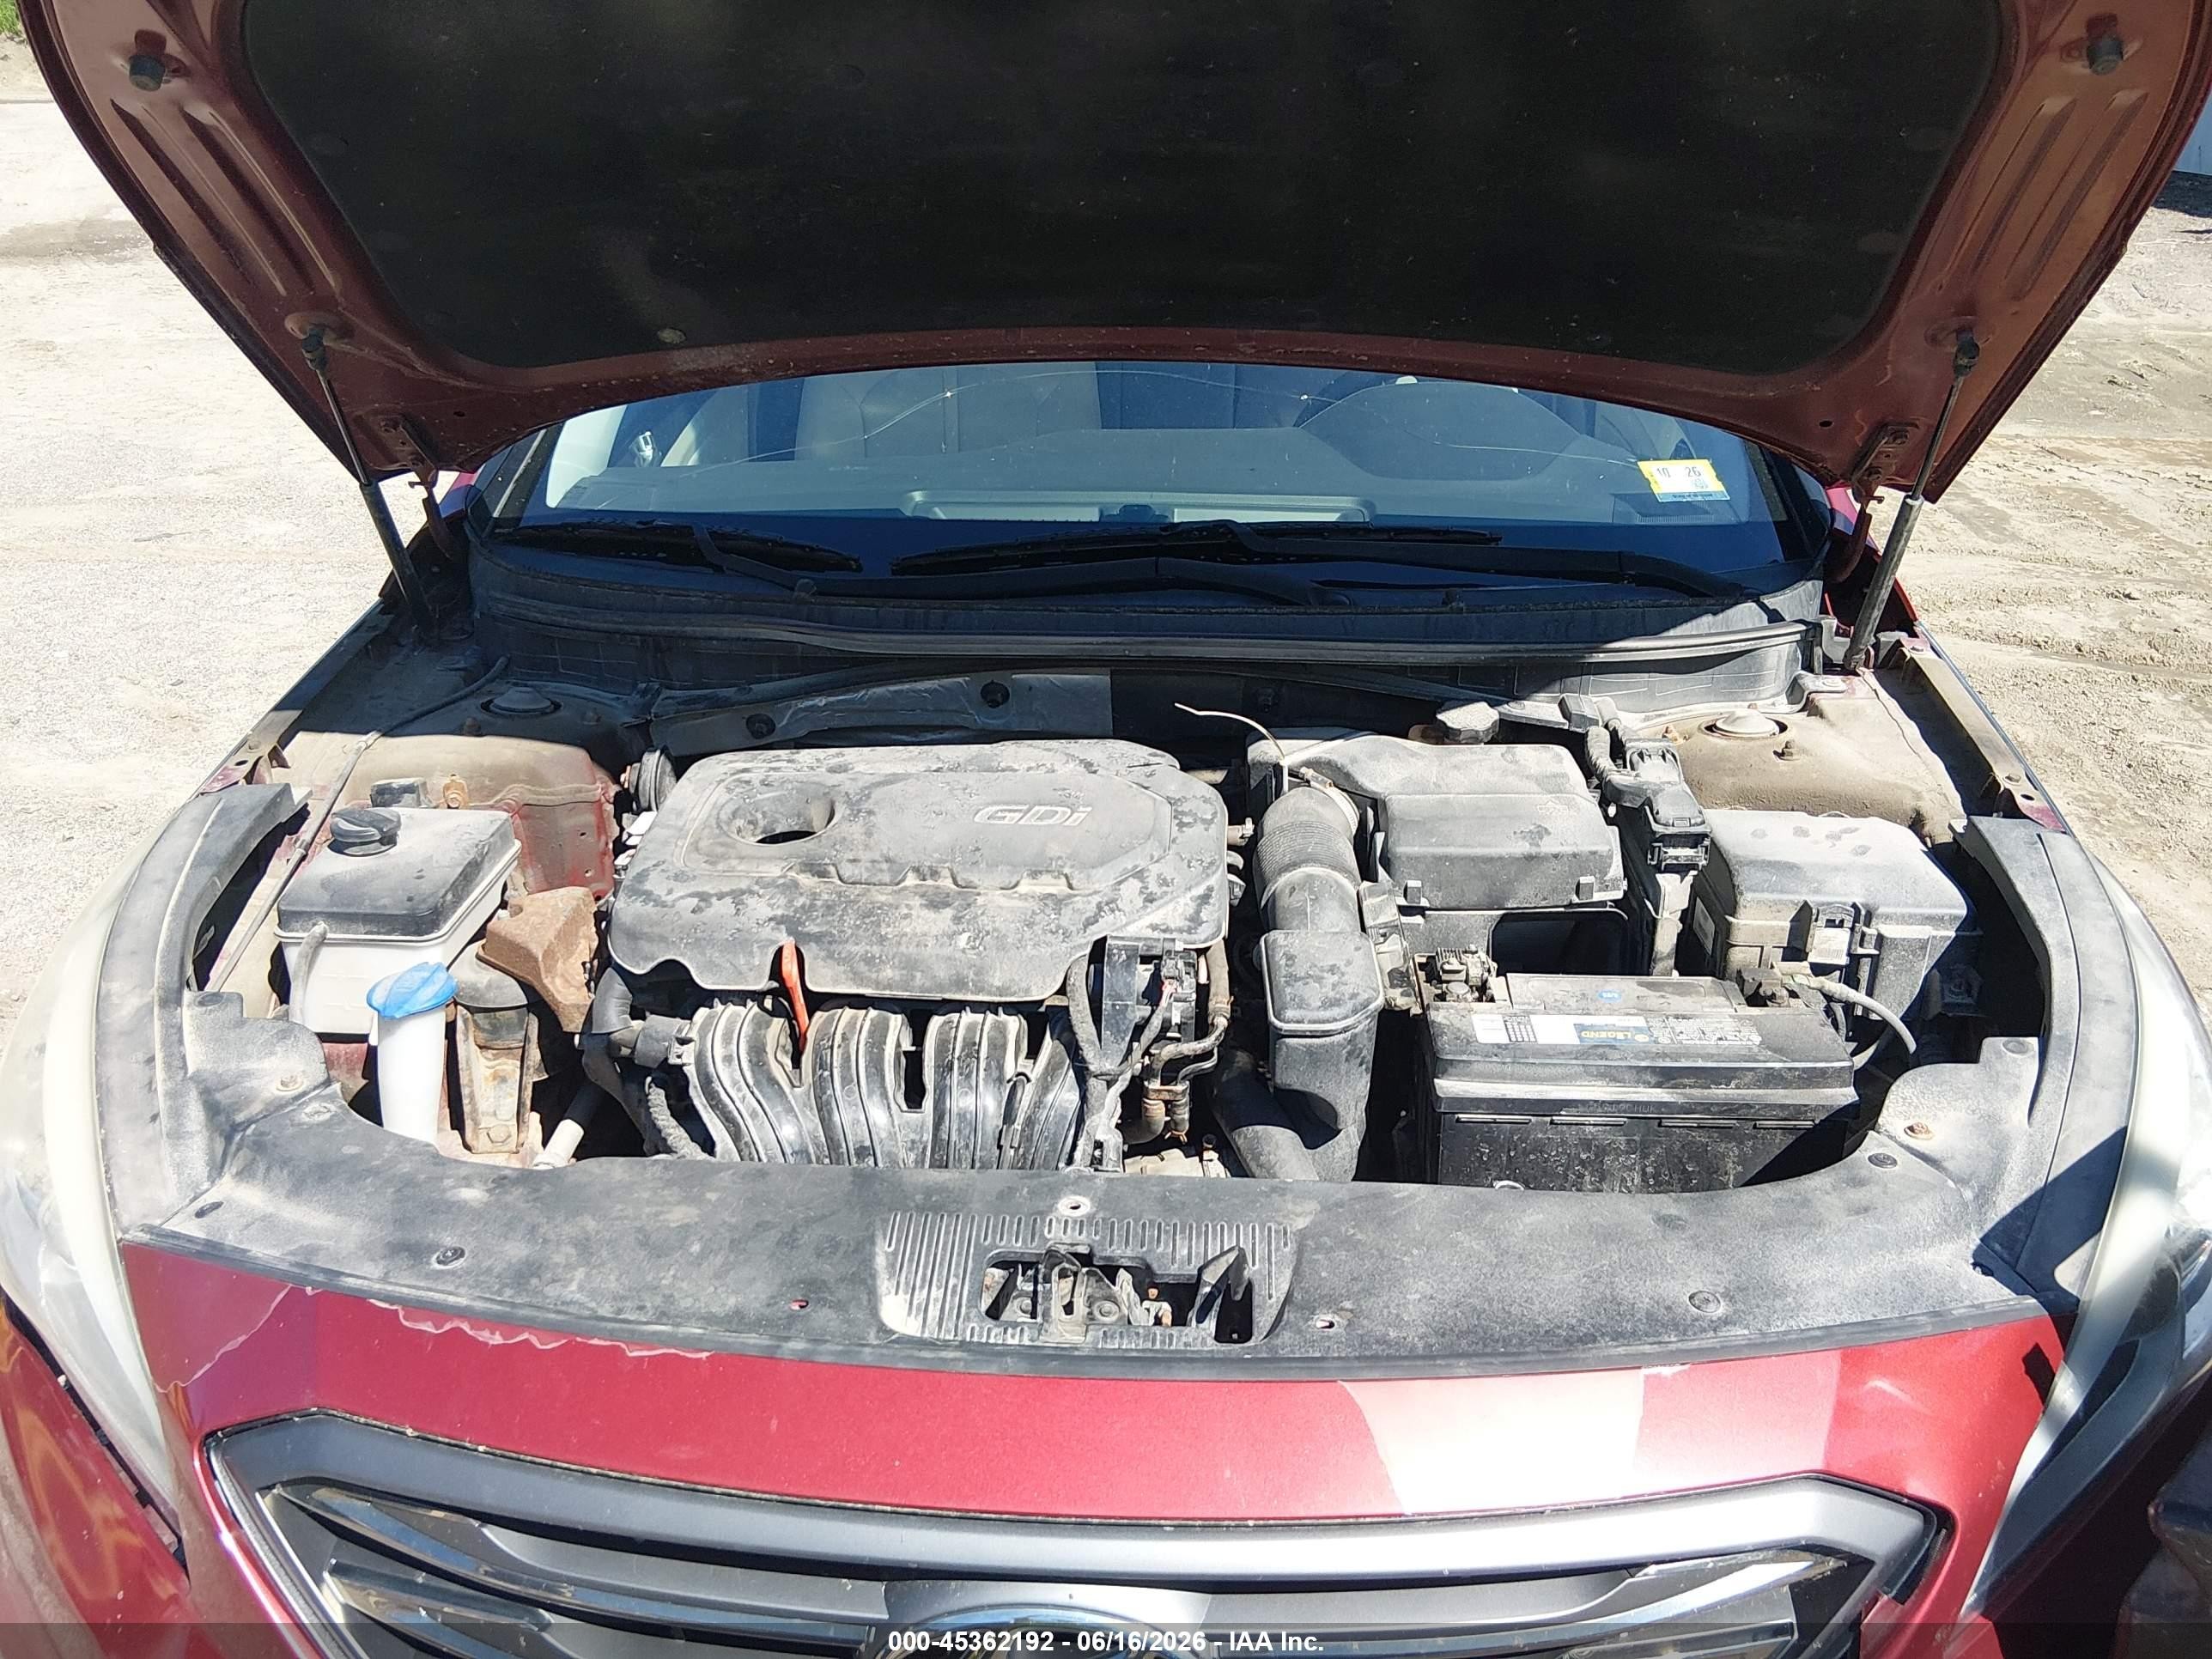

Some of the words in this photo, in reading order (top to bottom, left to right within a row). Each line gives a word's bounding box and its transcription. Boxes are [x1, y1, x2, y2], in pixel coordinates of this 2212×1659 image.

[1685, 466, 1701, 477] 26
[974, 803, 1093, 826] GDi
[1580, 1030, 1632, 1040] LEGEND
